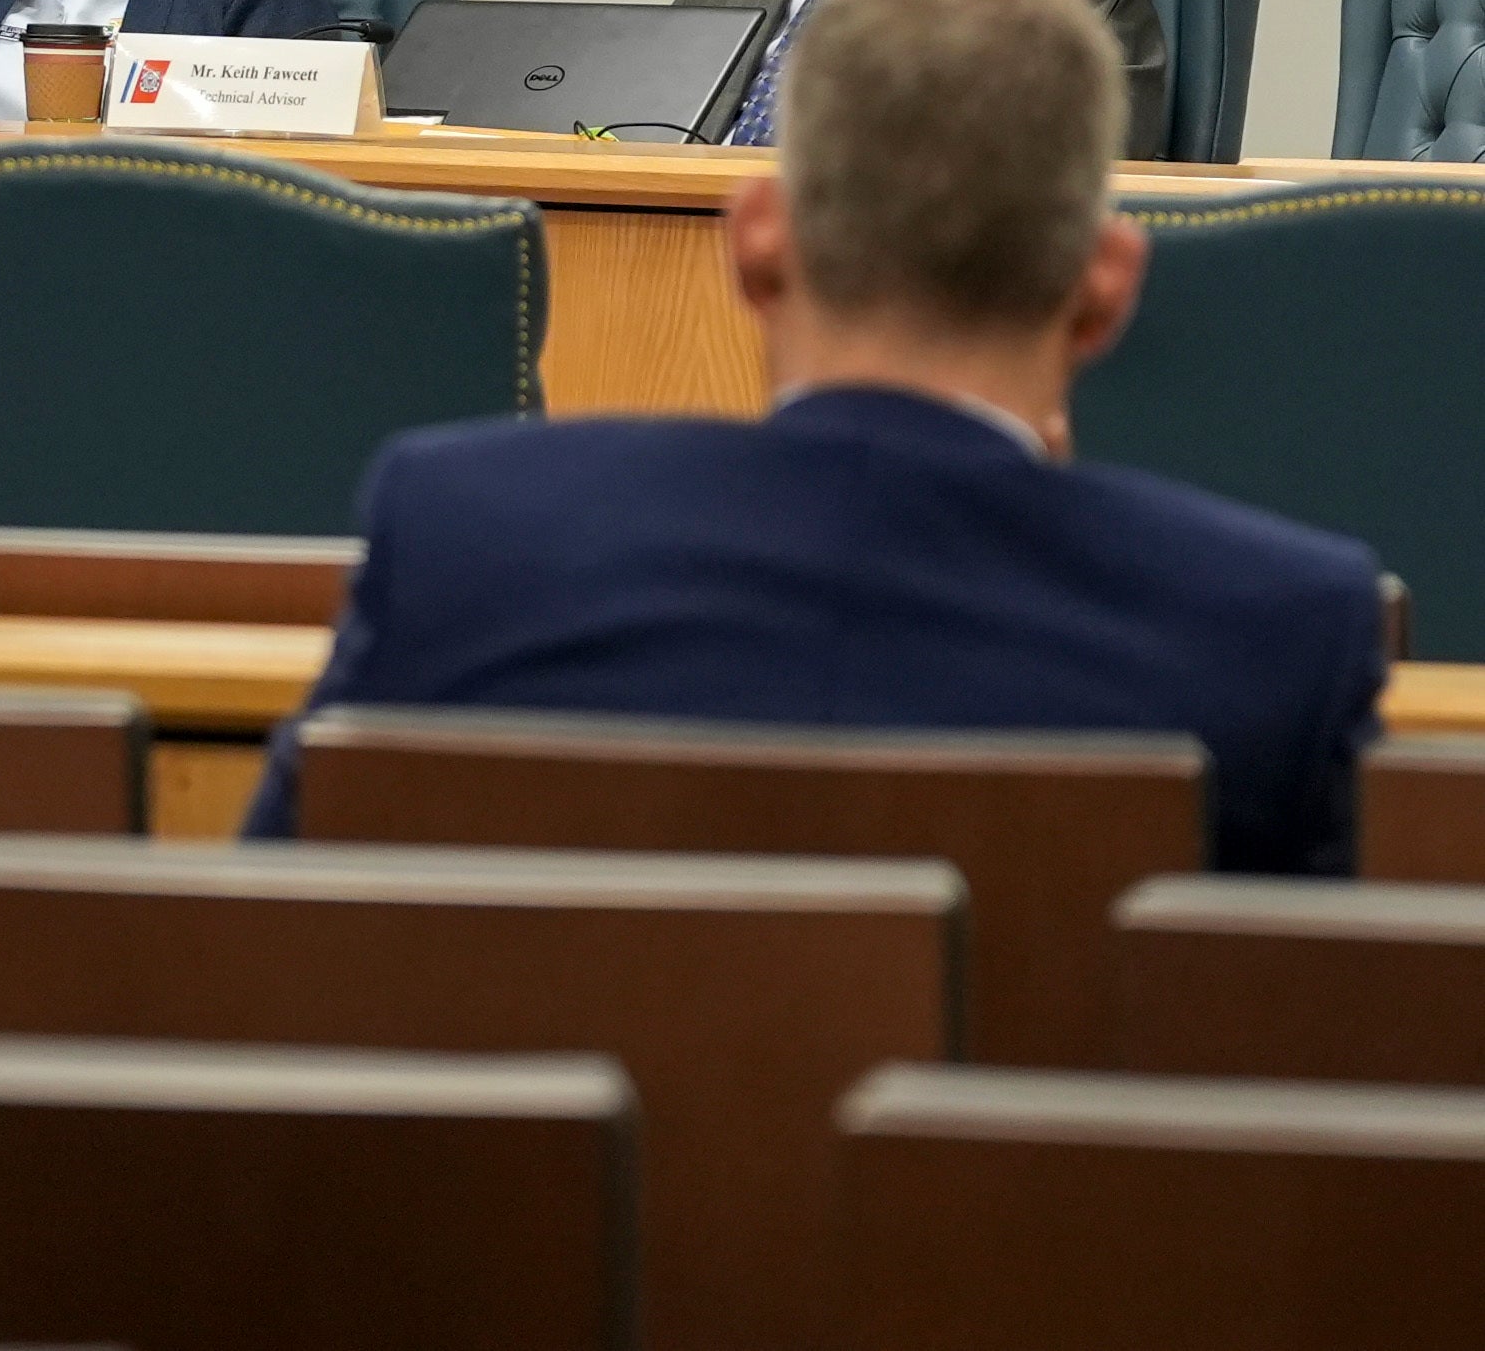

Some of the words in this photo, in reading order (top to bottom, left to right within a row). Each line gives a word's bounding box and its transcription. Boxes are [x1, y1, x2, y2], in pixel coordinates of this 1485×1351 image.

[191, 64, 215, 78] Mr.
[221, 64, 259, 80] Keith
[263, 66, 319, 82] Fawcett
[256, 91, 306, 107] Advisor
